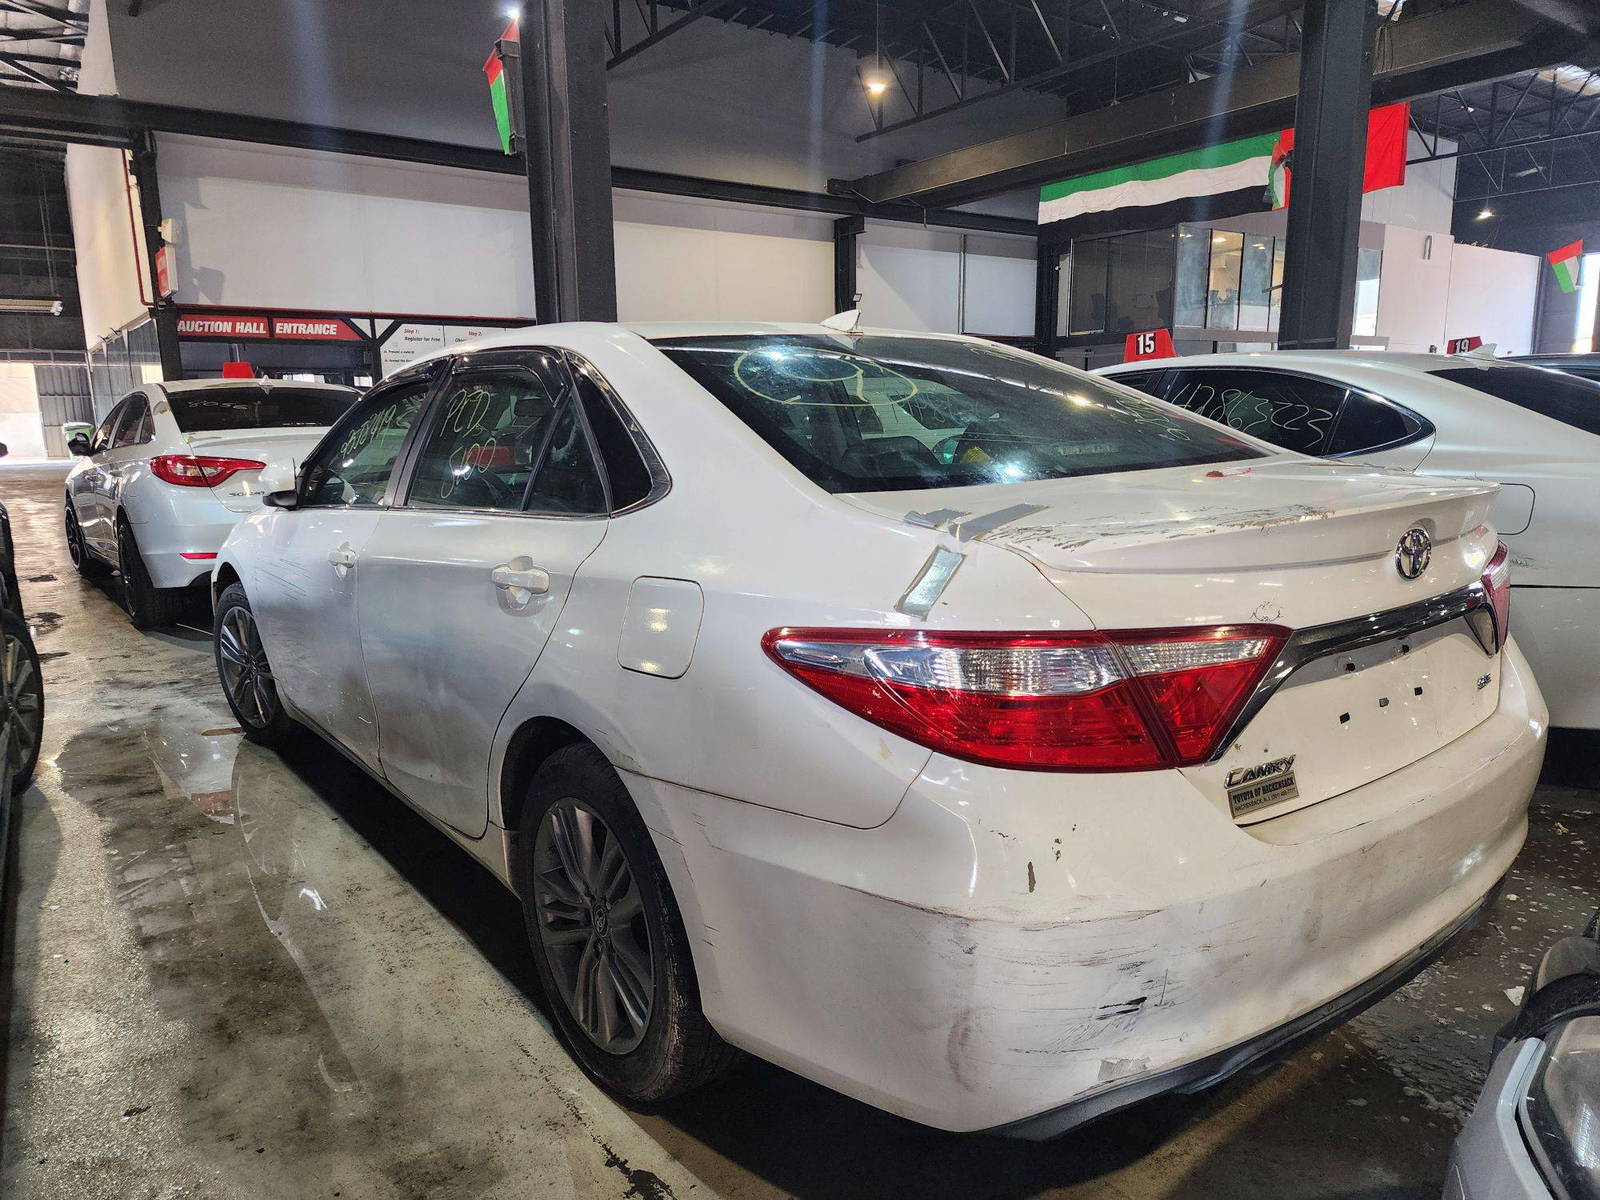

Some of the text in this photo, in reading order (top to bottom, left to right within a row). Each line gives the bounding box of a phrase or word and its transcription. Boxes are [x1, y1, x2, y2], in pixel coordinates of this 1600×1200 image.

[177, 320, 338, 335] AUCTION HALL ENTRANCE
[1137, 332, 1155, 355] 15
[1456, 339, 1470, 353] 19
[1224, 753, 1296, 789] CAMRY
[1232, 790, 1255, 803] TOYOTA
[1254, 787, 1262, 797] OF
